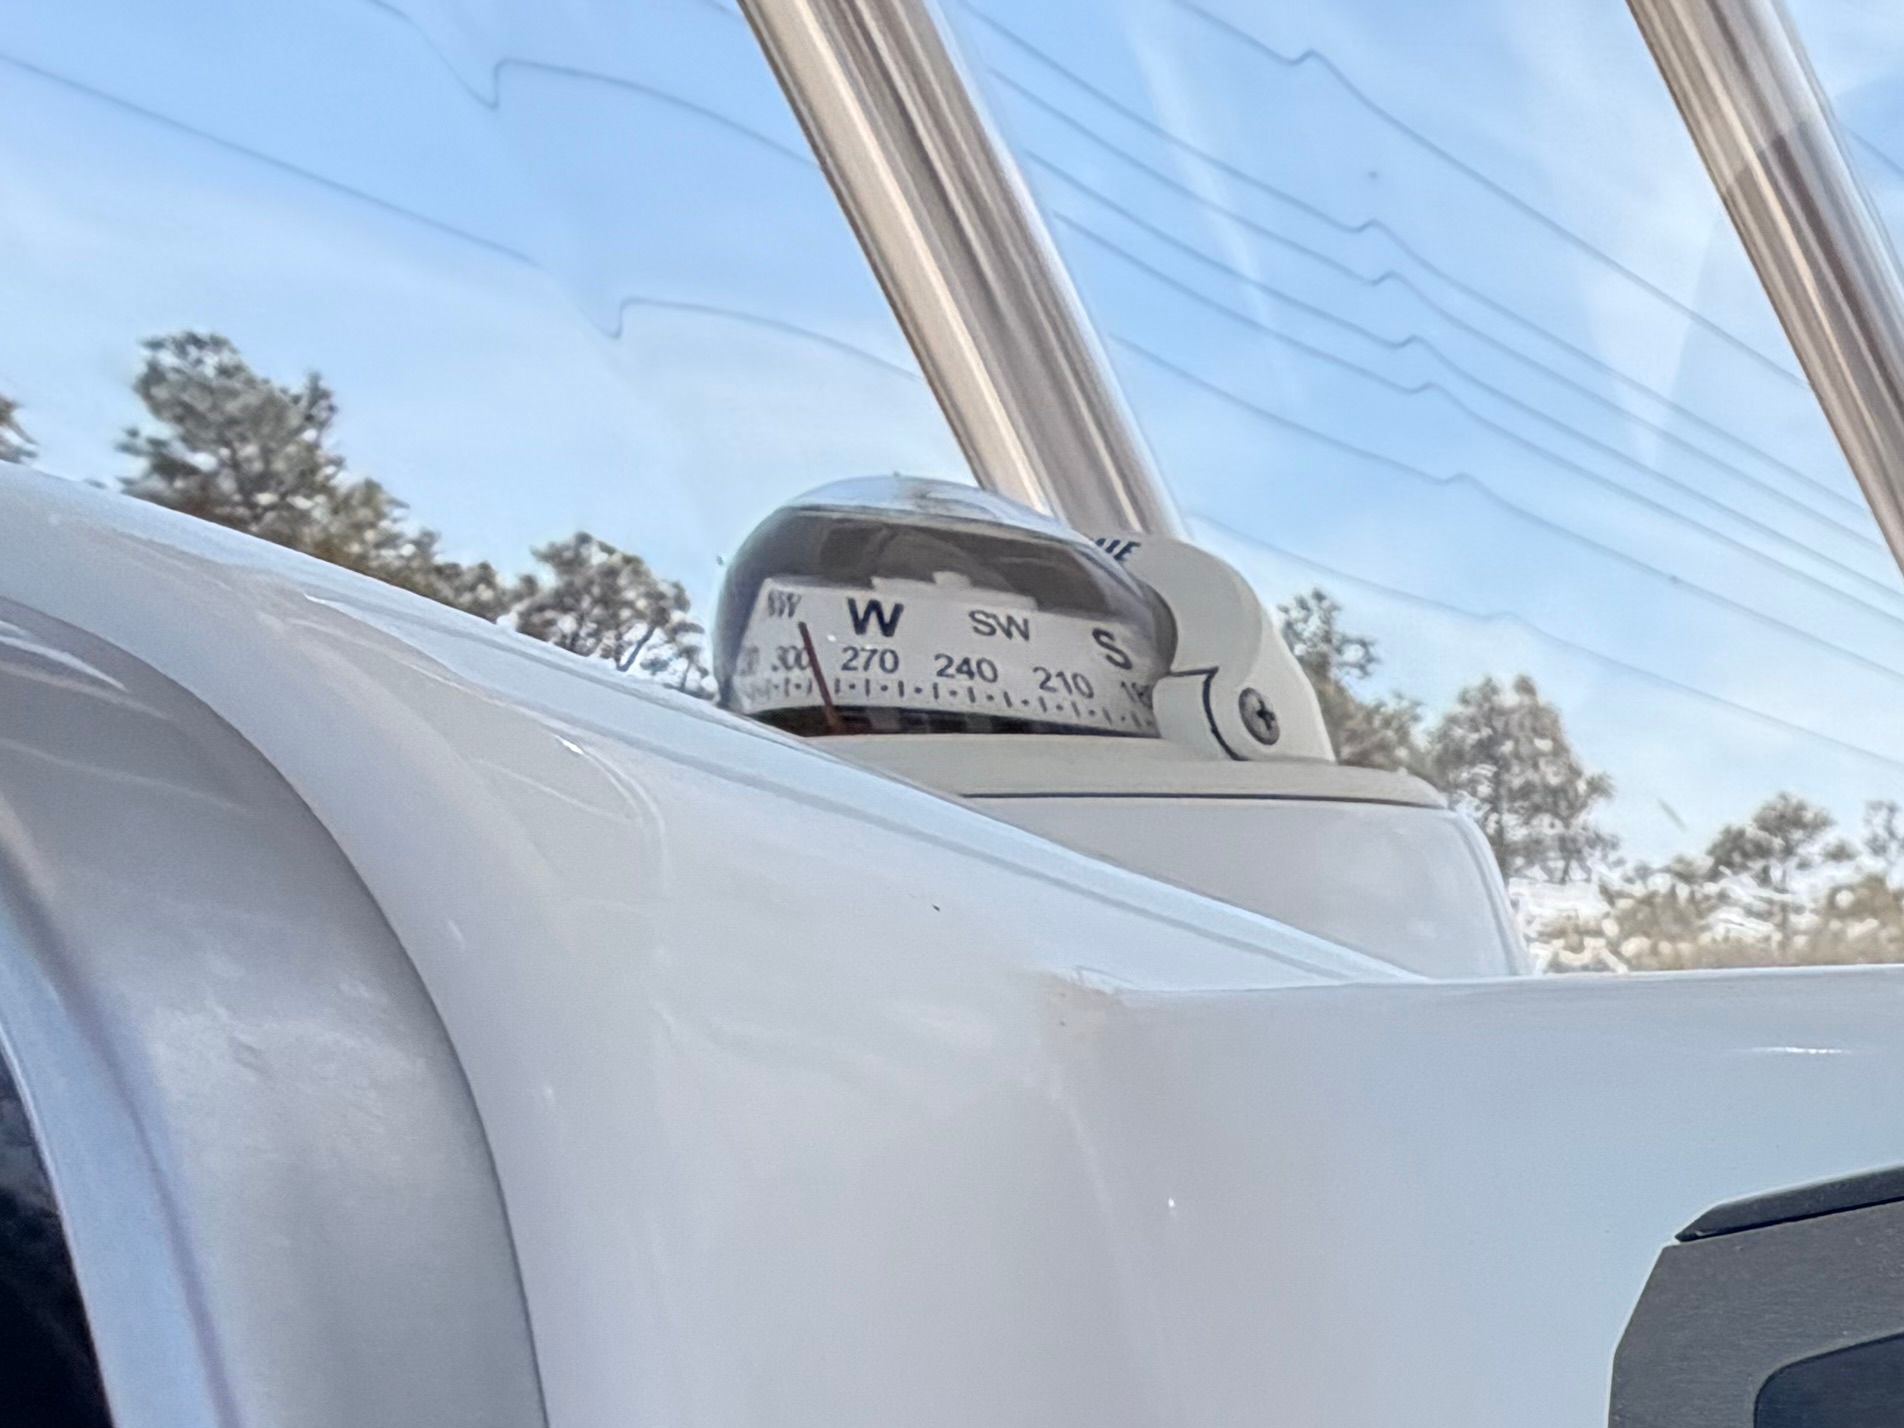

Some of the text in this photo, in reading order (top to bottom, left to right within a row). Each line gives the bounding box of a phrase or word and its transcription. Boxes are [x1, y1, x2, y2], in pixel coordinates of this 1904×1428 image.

[847, 598, 905, 638] W
[968, 609, 1031, 642] SW
[1092, 627, 1133, 670] S
[842, 646, 900, 675] 270
[934, 653, 999, 684] 240
[1033, 667, 1095, 700] 210
